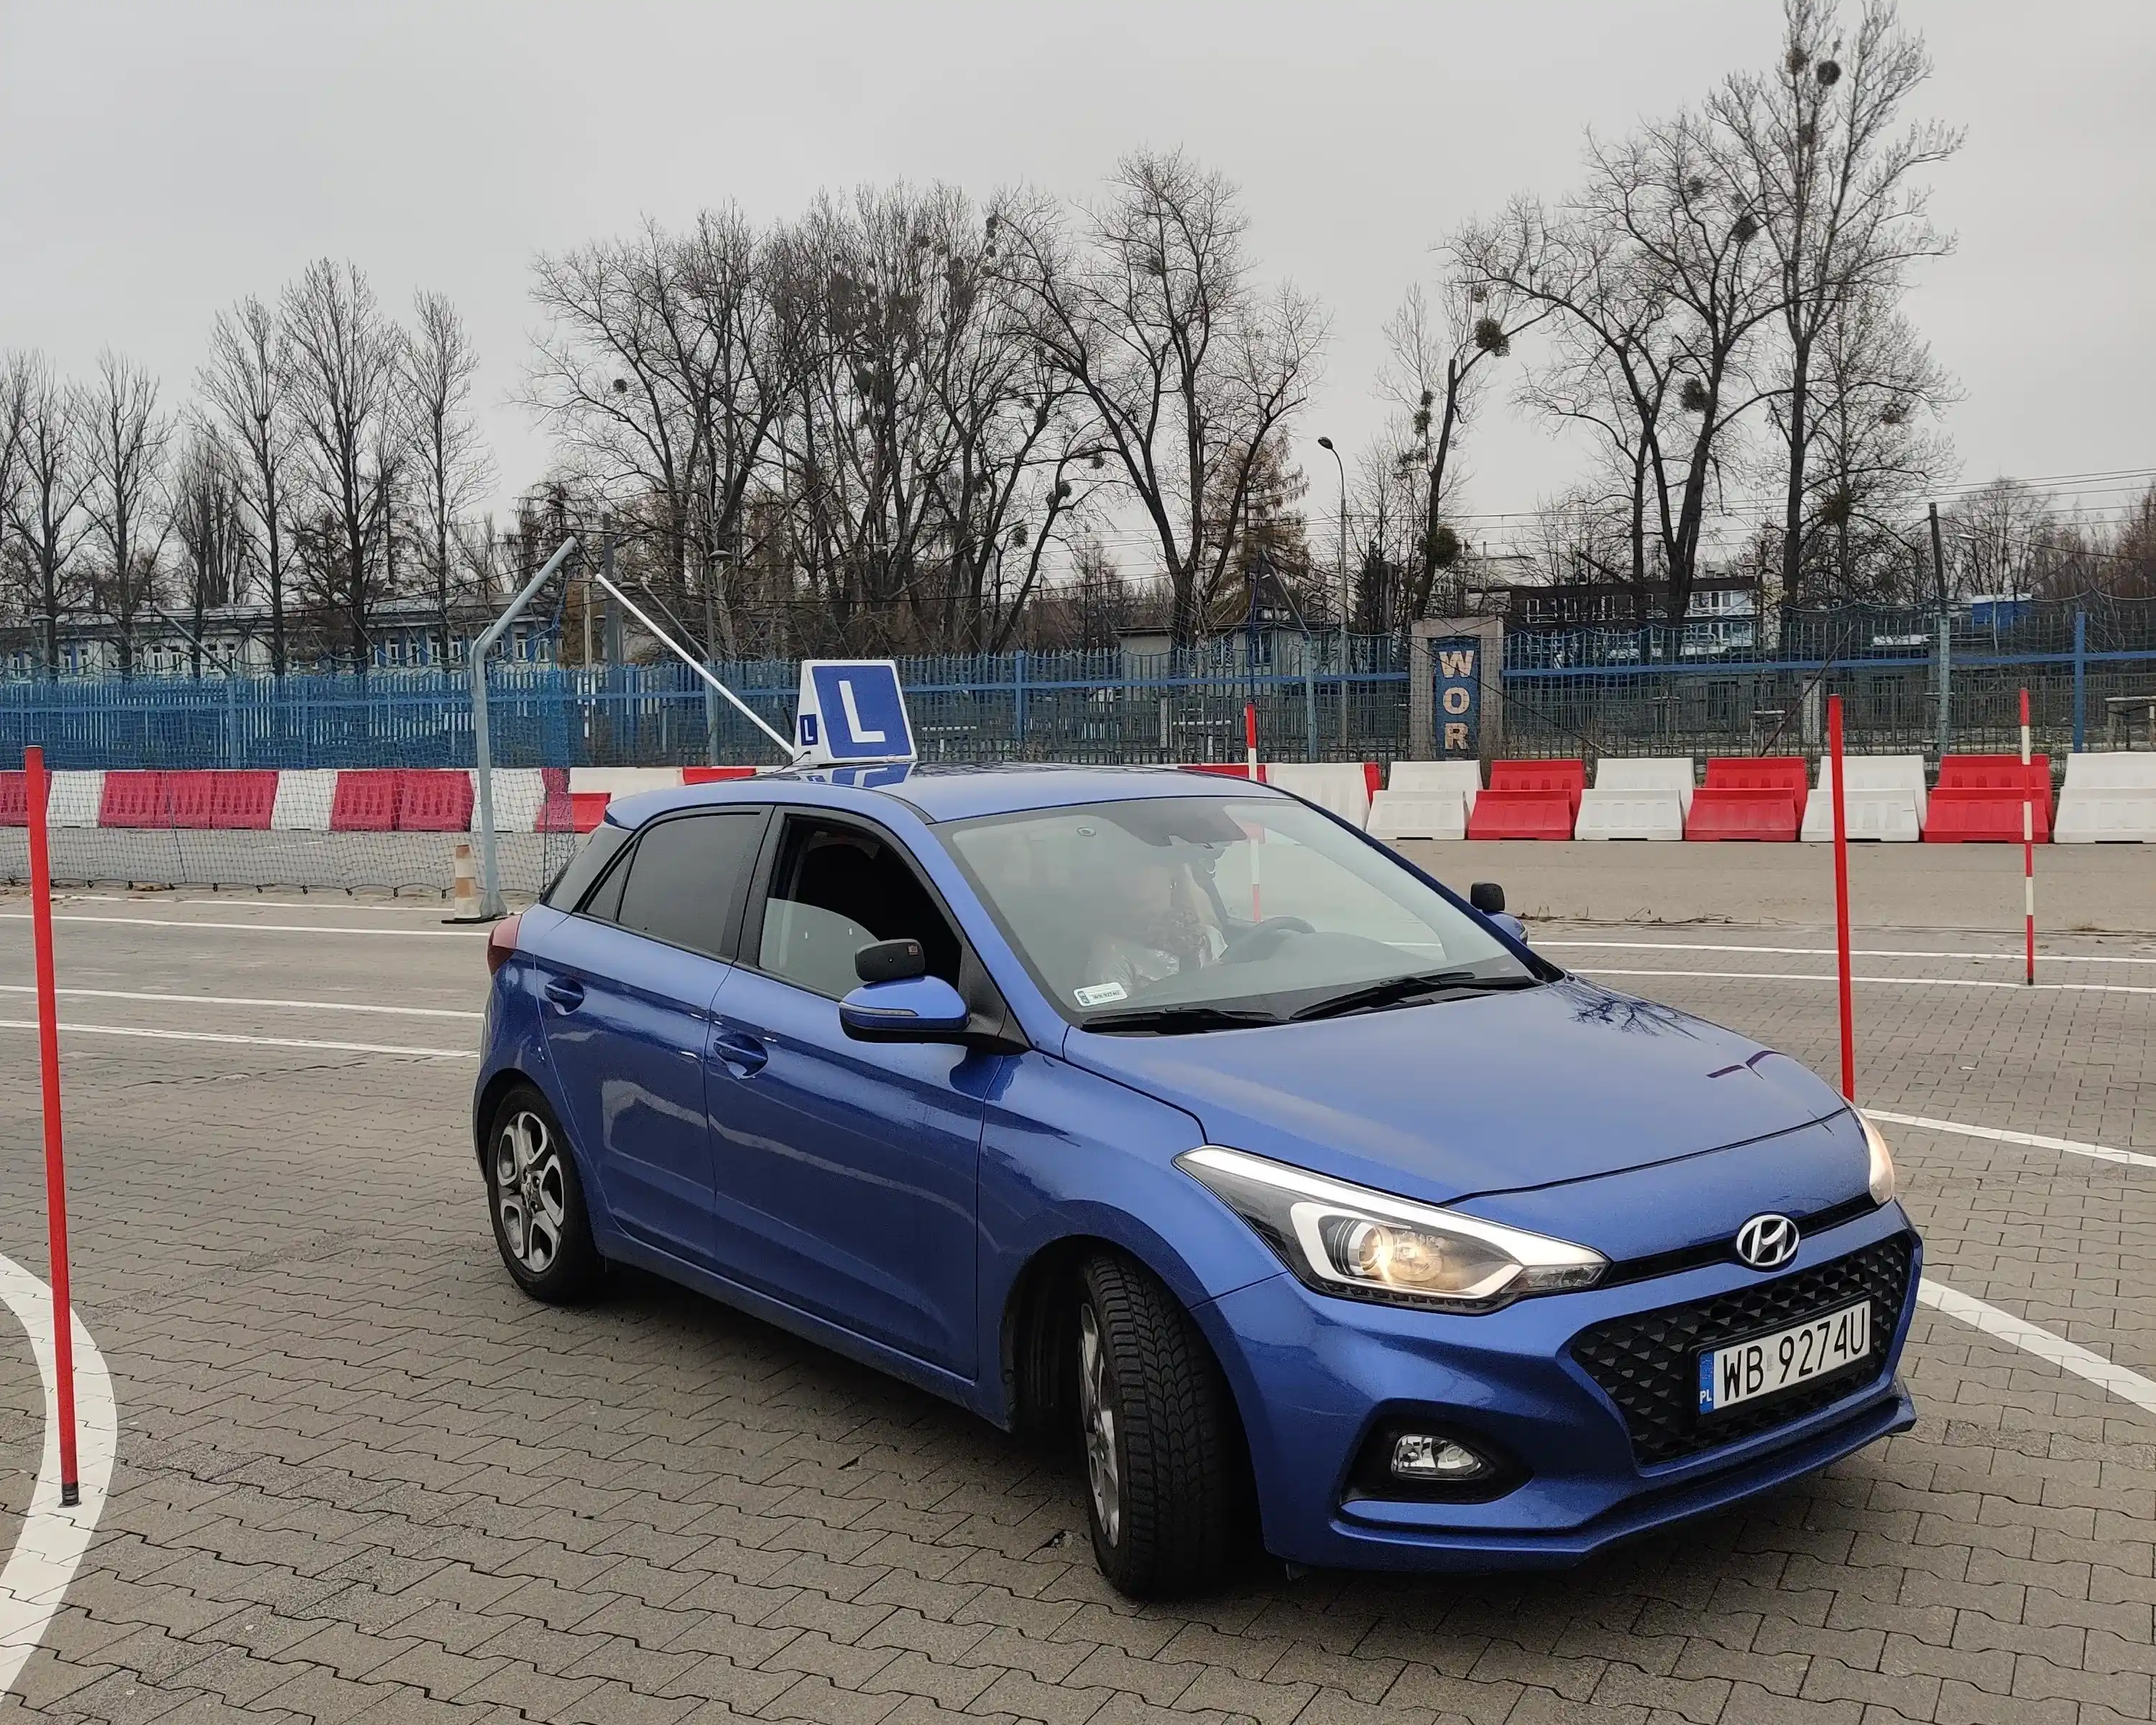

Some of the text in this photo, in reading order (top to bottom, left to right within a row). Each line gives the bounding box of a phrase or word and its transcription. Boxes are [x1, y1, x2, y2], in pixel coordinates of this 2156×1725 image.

[804, 719, 814, 741] L
[838, 680, 885, 743] L
[1438, 650, 1475, 760] WOR
[1723, 1307, 1866, 1401] WB 9274U
[1700, 1389, 1713, 1404] PL
